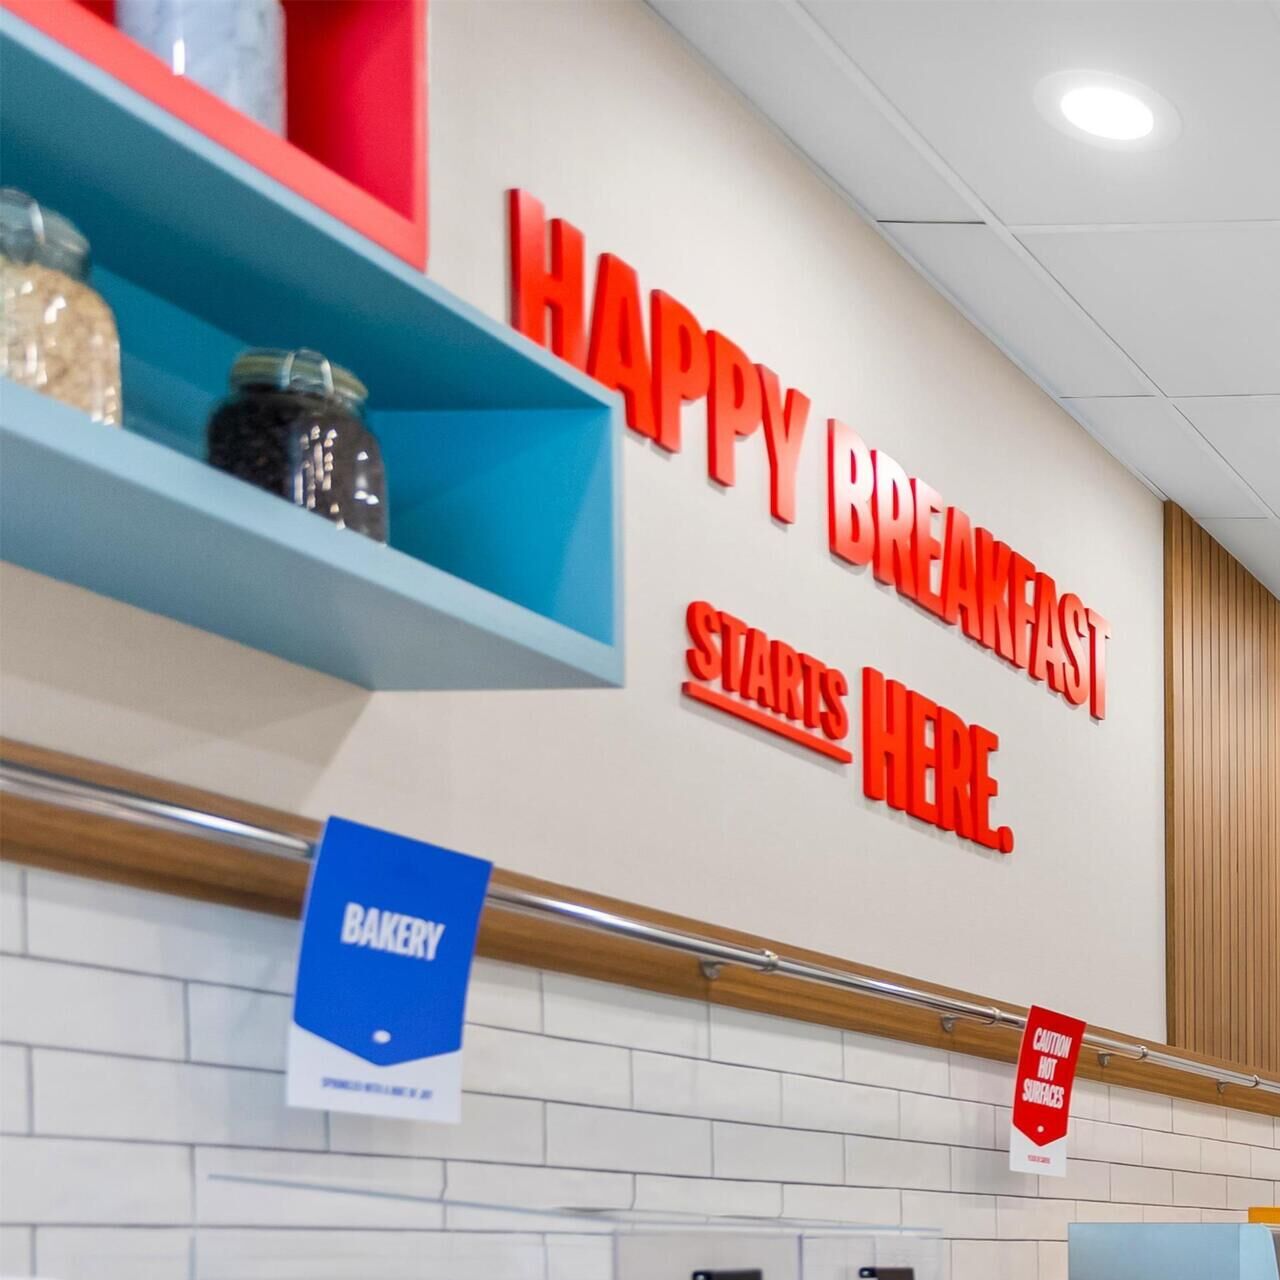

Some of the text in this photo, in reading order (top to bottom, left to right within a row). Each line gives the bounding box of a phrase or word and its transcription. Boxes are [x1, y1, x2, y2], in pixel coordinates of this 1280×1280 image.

[505, 188, 1111, 721] HAPPY BREAKFAST
[685, 600, 1014, 854] STARTS HERE.
[340, 901, 446, 962] BAKERY
[1032, 1027, 1073, 1059] CAUTION
[1036, 1056, 1059, 1081] HOT
[1021, 1078, 1065, 1110] SURFACES
